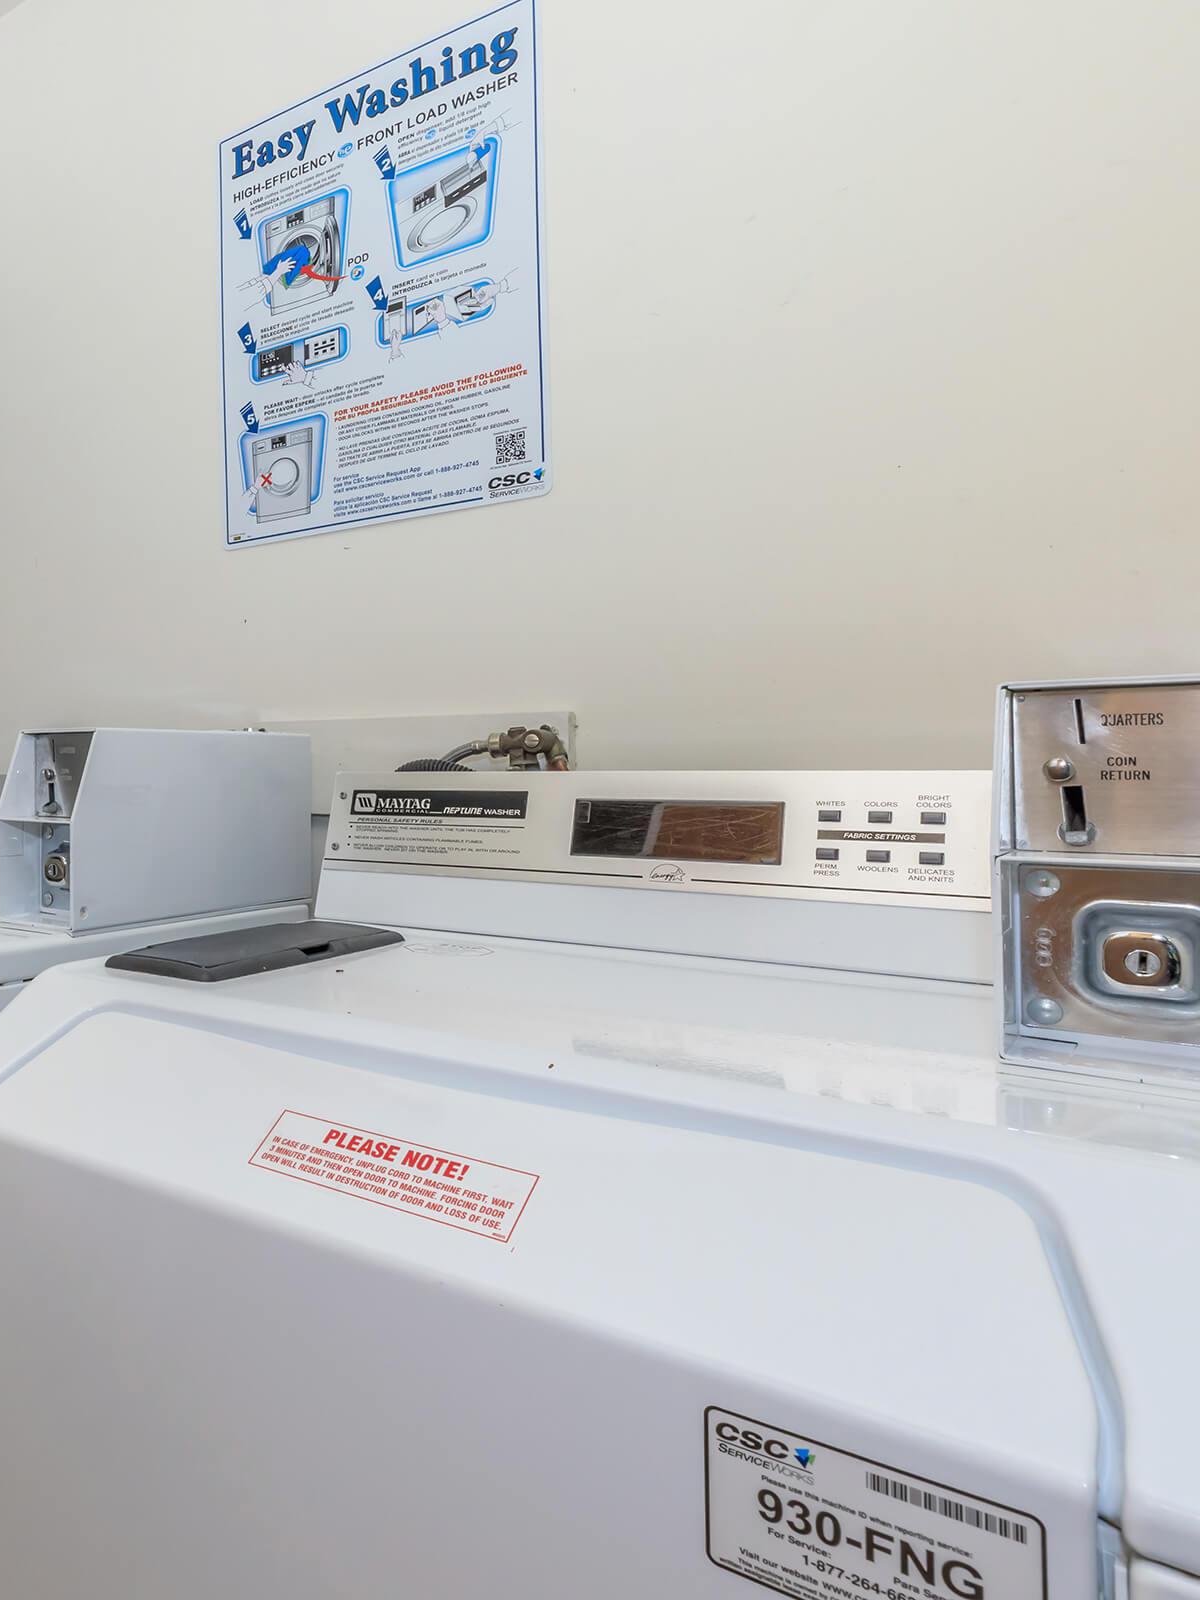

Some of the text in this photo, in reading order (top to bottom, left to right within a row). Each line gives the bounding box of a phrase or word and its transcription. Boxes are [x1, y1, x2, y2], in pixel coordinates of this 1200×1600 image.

[232, 27, 518, 179] Easy Washing
[233, 72, 518, 203] HIGH-EFFICIENCY FRONT LOAD WASHER
[382, 159, 391, 171] 2
[241, 223, 247, 232] 1
[348, 252, 370, 268] POD
[374, 289, 383, 300] 4
[244, 335, 253, 345] 3
[334, 363, 521, 417] FOR YOUR SAFETY PLEASE AVOID THE FOLLOWING
[361, 405, 385, 416] PROPIA
[443, 385, 463, 395] FAVOR
[465, 380, 483, 389] EVITE
[495, 369, 527, 382] SIGUIENTE
[247, 415, 254, 425] 5
[388, 468, 409, 476] Request
[488, 472, 530, 489] CSC
[1100, 713, 1164, 726] QUARTERS
[1100, 770, 1150, 780] RETURN
[1107, 757, 1136, 766] COIN
[376, 799, 431, 809] MAYTAG
[322, 1129, 470, 1181] PLEASE NOTE!
[268, 1145, 504, 1219] 3 MINUTES AND THEN OPEN DOOR TO MACHINE. FORCING DOOR
[272, 1135, 513, 1210] IN CASE OF EMERGENCY, UNPLUG CORD TO MACHINE FIRST, WAIT
[260, 1152, 503, 1230] OPEN WILL RESULT IN DESTRUCTION OF DOOR AND LOSS OF USE.
[716, 1422, 789, 1459] CSC
[761, 1474, 971, 1558] Please use this machine ID when reporting service:
[758, 1489, 983, 1600] 930-FNG
[767, 1527, 832, 1559] For Service:
[740, 1547, 766, 1565] Visit
[770, 1559, 787, 1574] our
[792, 1567, 828, 1590] website
[802, 1555, 916, 1600] 1-877-264-66
[894, 1576, 920, 1594] Para
